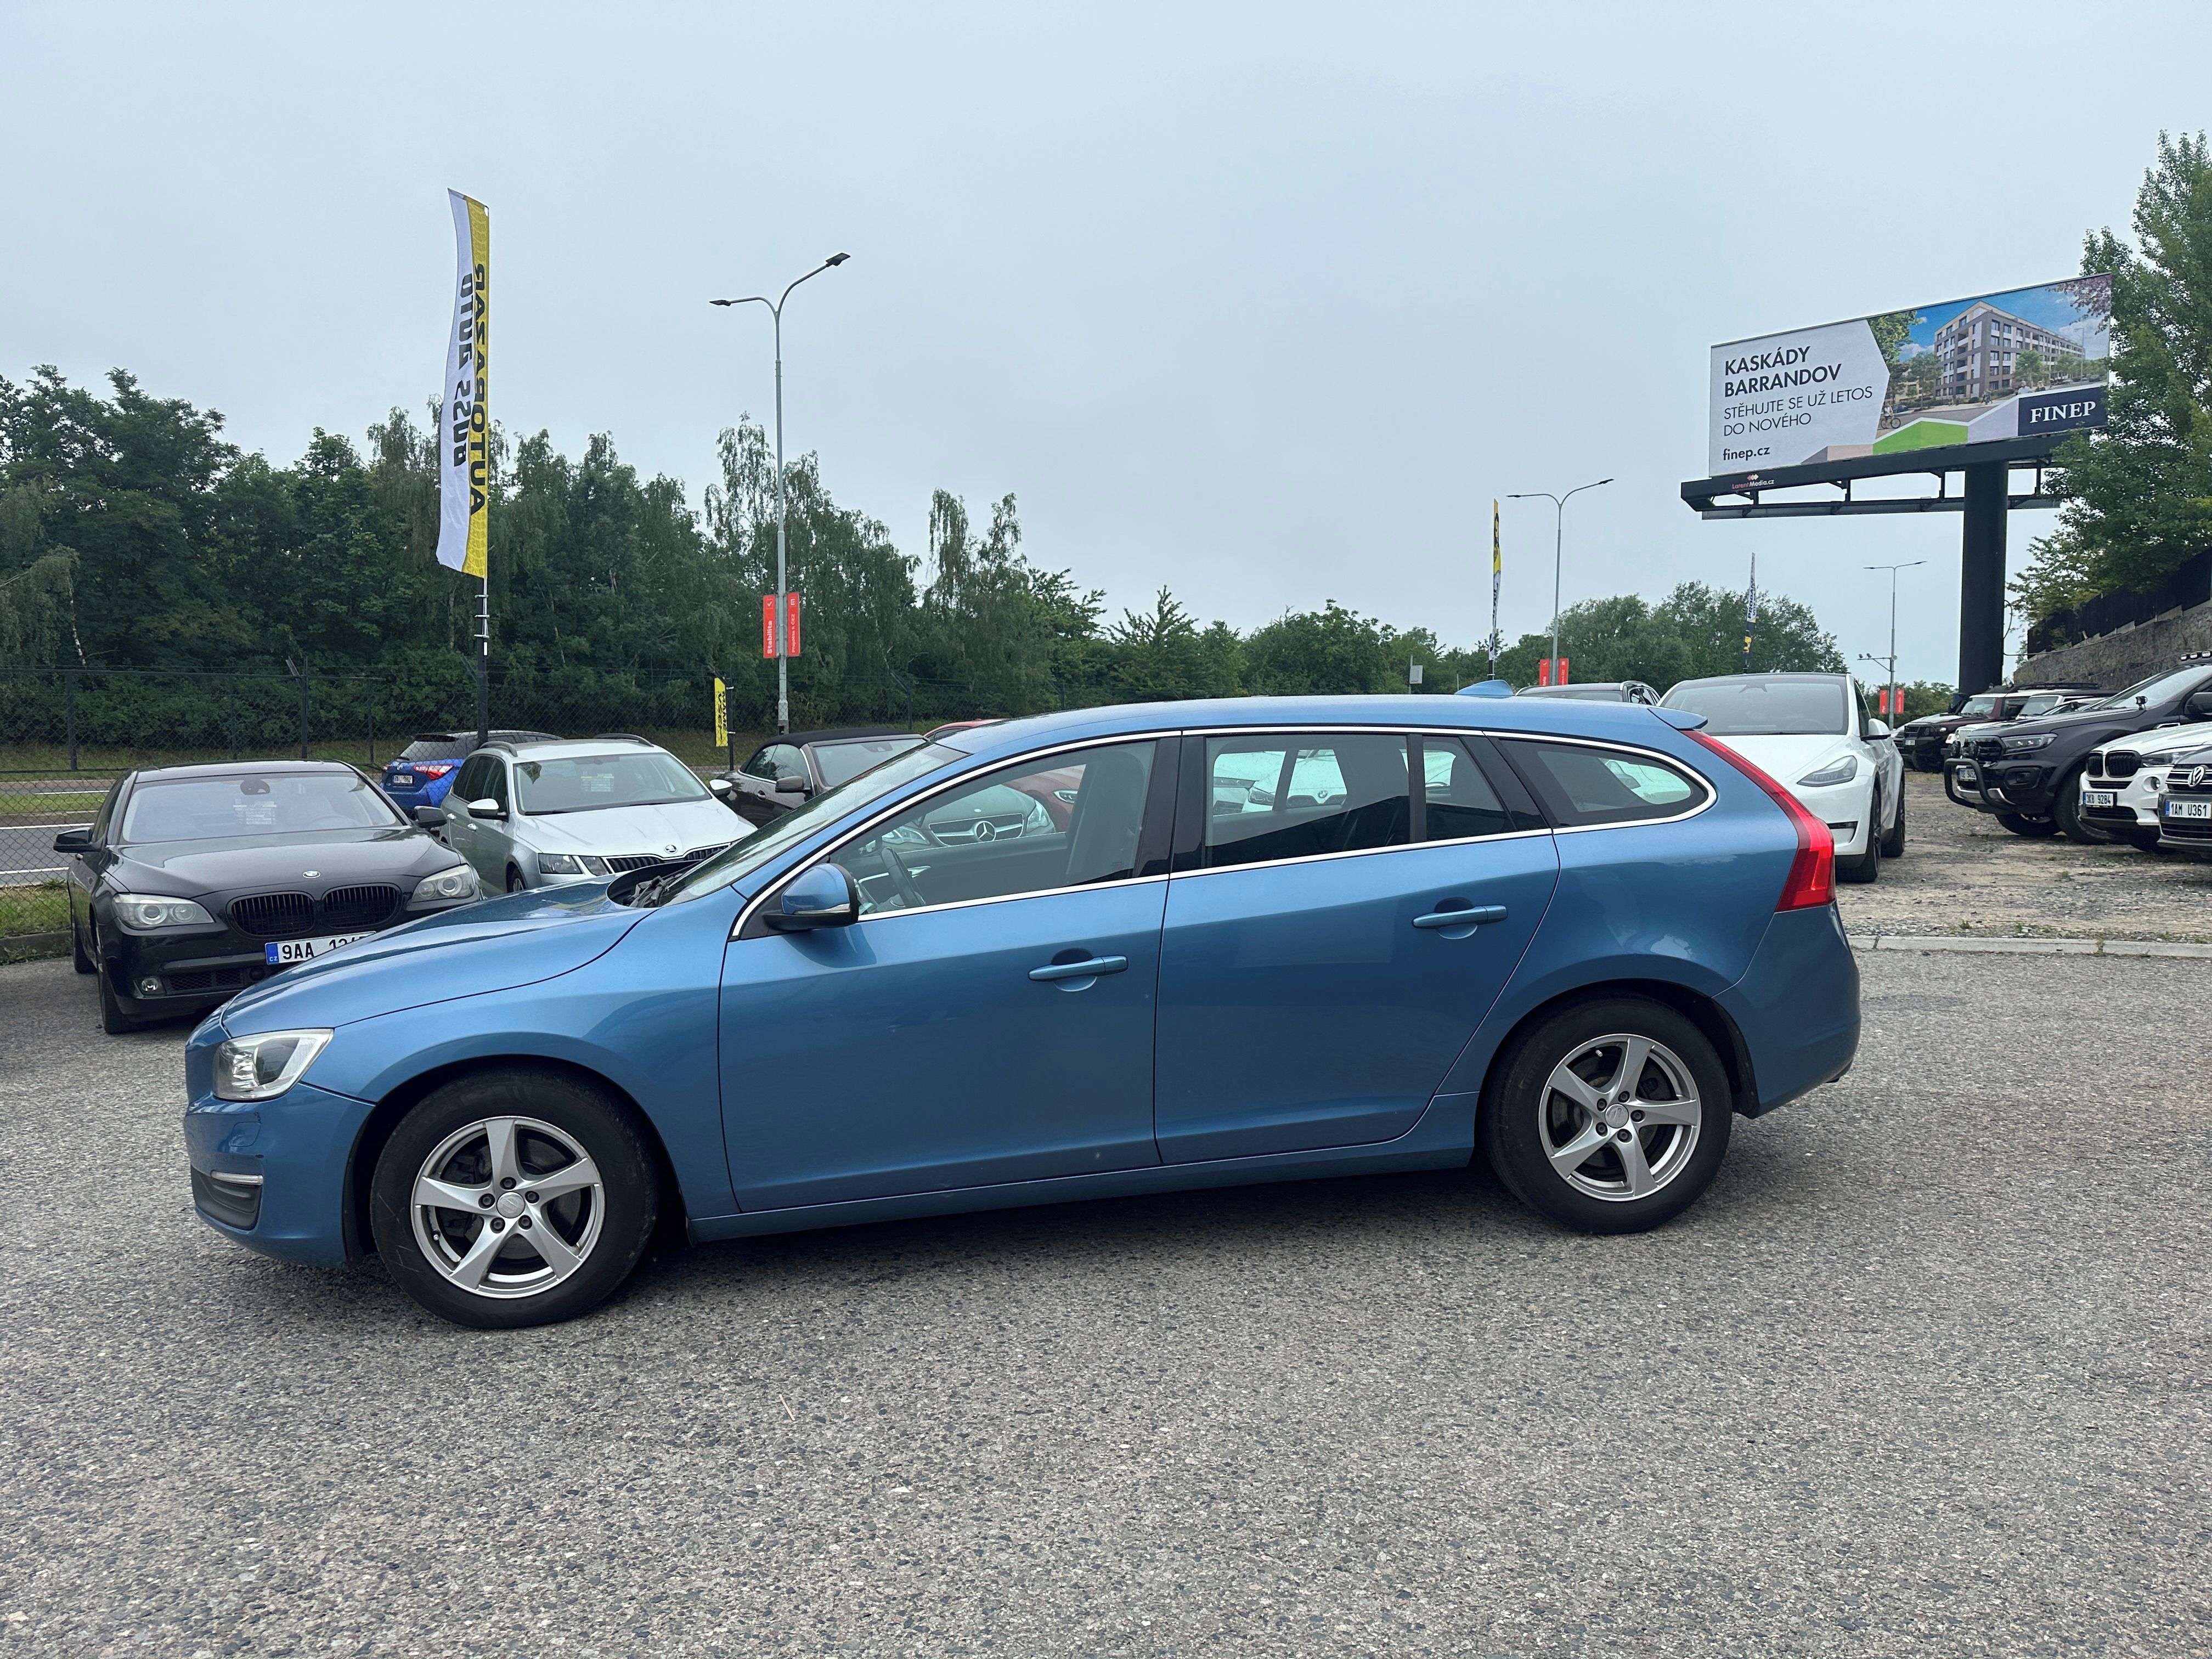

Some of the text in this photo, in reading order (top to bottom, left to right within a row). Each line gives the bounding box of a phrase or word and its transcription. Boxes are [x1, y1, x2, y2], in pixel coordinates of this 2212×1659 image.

[1725, 346, 1810, 376] KASKÁDY
[1725, 364, 1842, 397] BARRANDOV
[1724, 386, 1872, 419] STĚHUJTE SE UŽ LETOS
[2030, 401, 2096, 424] FINEP
[1724, 413, 1812, 436] DO NOVÉHO
[1723, 447, 1770, 461] finep.cz
[2171, 804, 2207, 816] 1AM U361
[282, 942, 315, 960] 9AA
